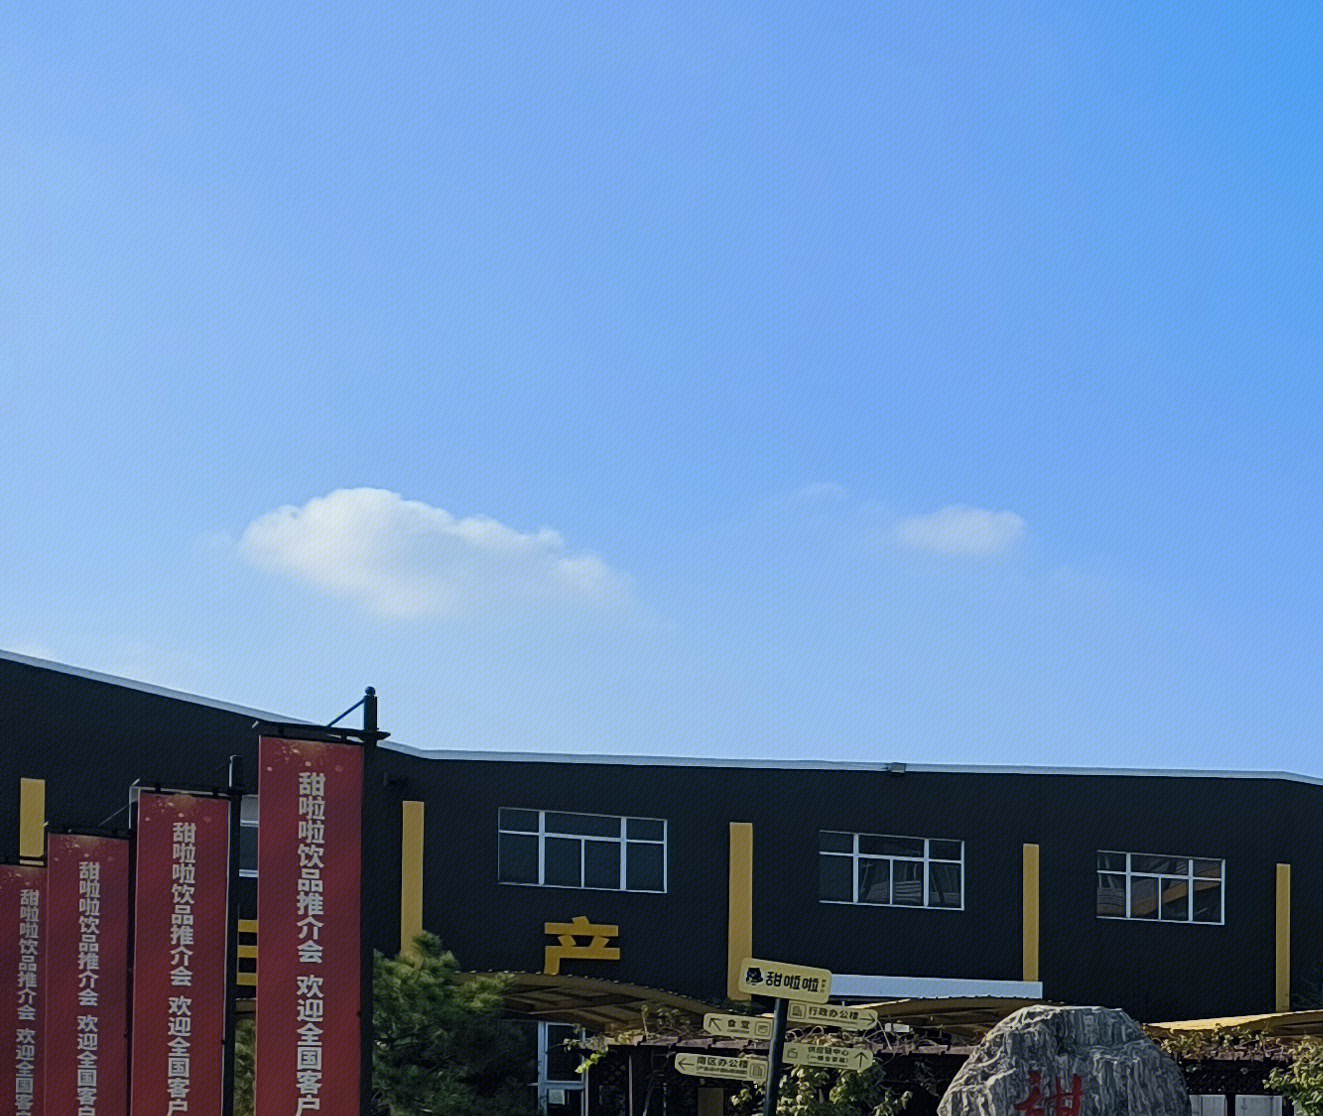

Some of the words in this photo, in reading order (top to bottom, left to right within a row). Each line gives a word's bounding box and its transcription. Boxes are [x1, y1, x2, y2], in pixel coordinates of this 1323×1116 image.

[171, 821, 197, 987] 甜啦啦饮品推介会
[297, 772, 326, 964] 甜啦啦饮品推介会
[17, 888, 41, 1021] 甜啦啦饮品推介会
[77, 861, 101, 1007] 甜啦啦饮品推介会
[544, 915, 622, 975] 产
[765, 971, 820, 992] 甜啦啦
[727, 1018, 751, 1030] 食堂
[808, 1006, 859, 1020] 行政办公楼
